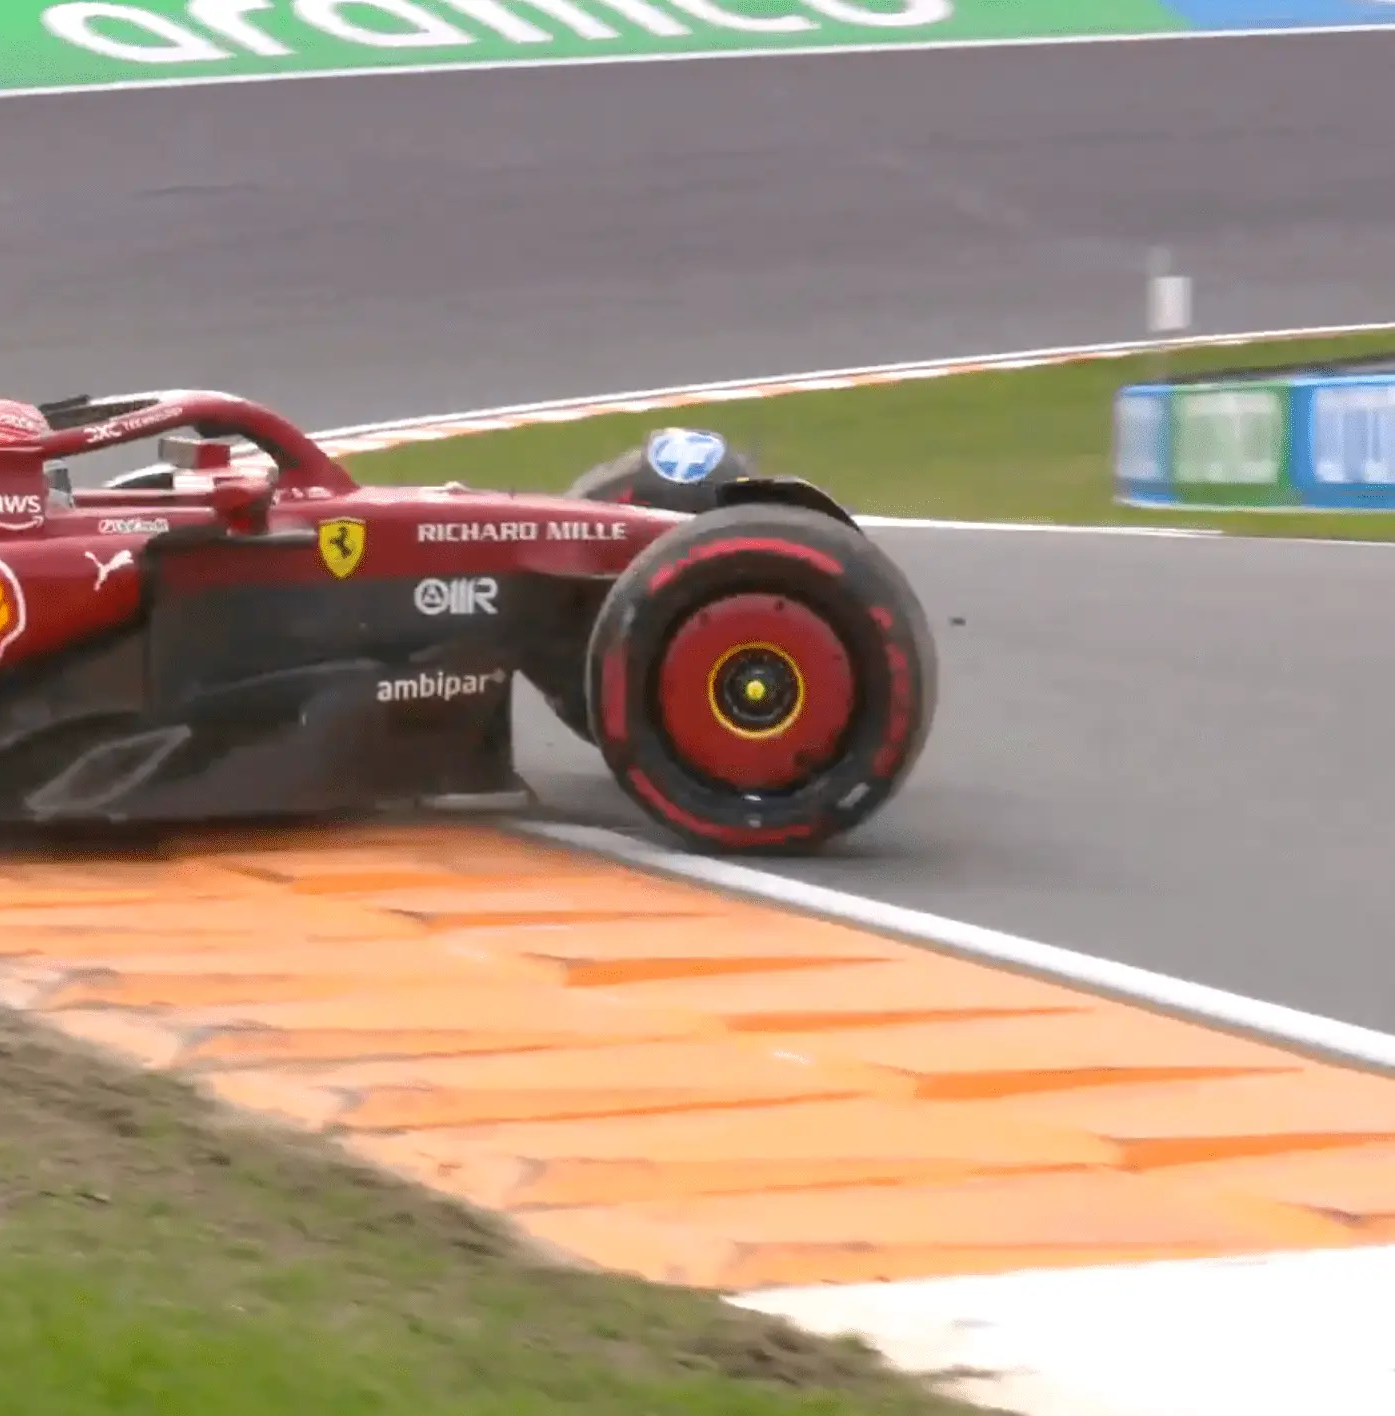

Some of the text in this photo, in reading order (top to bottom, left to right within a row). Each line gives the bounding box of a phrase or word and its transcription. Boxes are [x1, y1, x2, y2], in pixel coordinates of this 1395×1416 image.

[417, 521, 628, 542] RICHARD MILLE
[377, 670, 491, 703] ambipar
